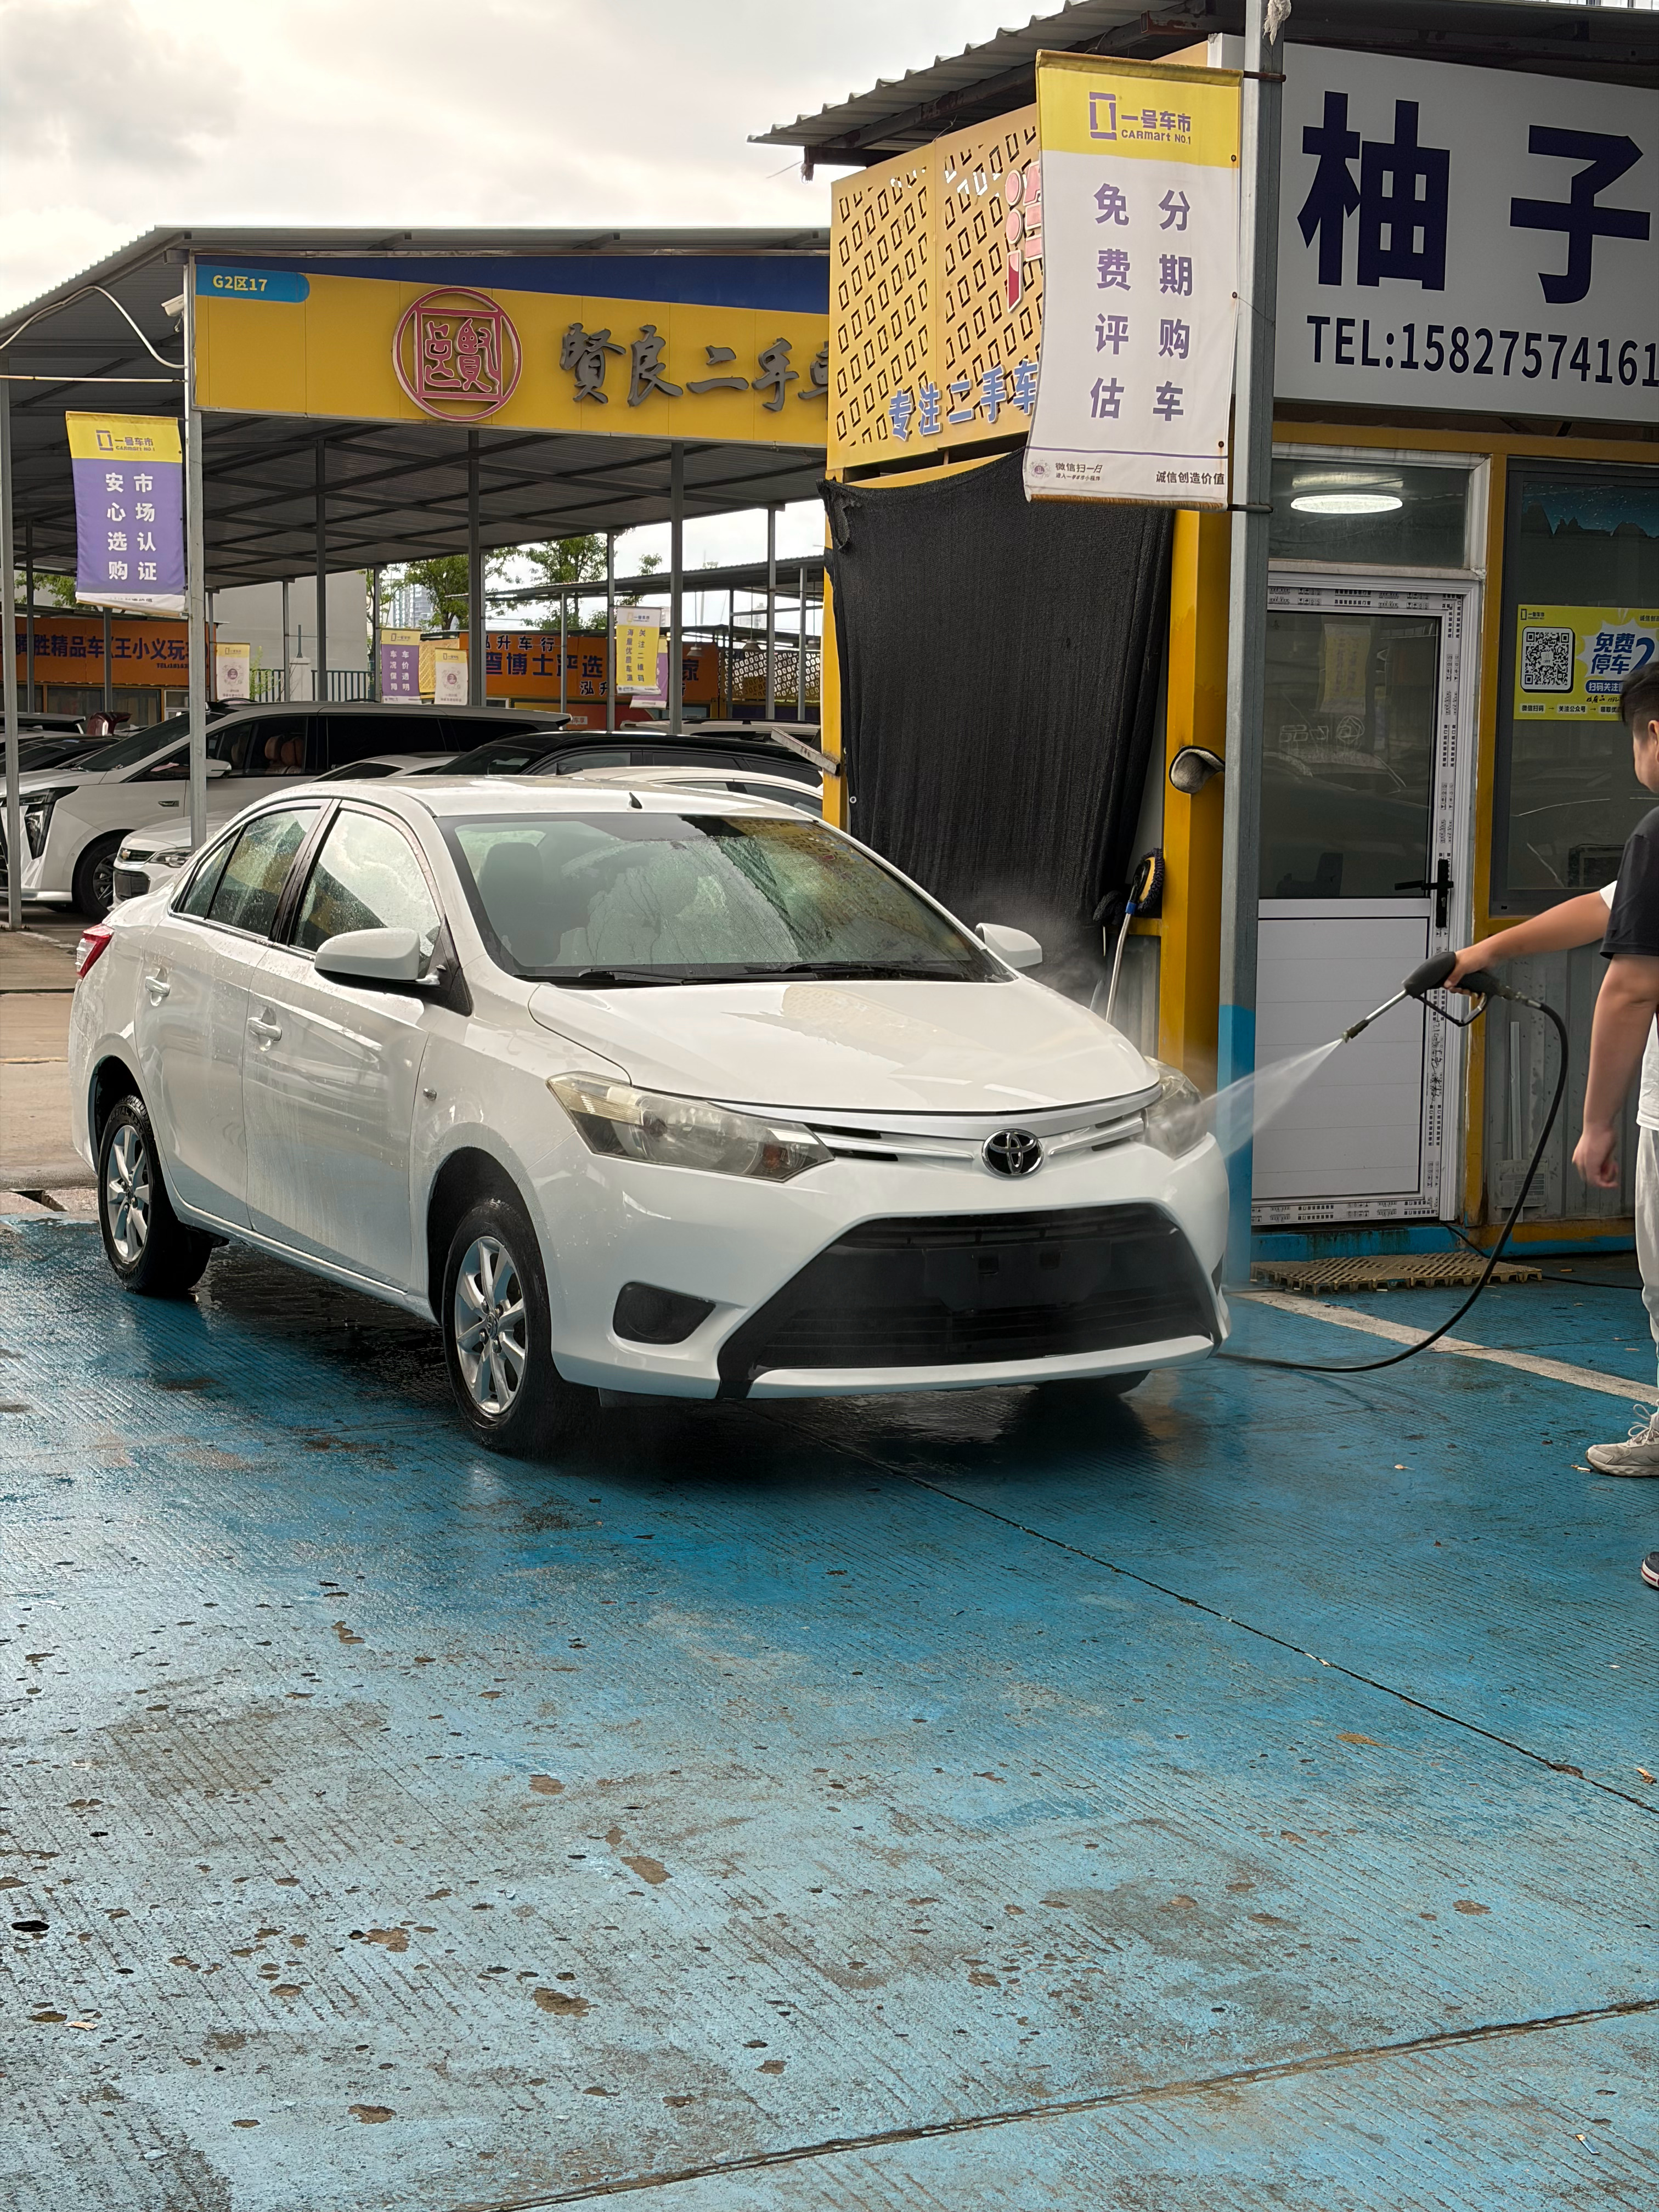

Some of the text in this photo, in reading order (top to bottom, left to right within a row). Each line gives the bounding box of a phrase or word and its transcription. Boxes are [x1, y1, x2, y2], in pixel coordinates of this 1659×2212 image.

[1121, 109, 1191, 133] 一号车市
[1121, 129, 1171, 142] CARmart
[1297, 91, 1651, 303] 柚子
[213, 275, 268, 291] G2区17
[1090, 183, 1131, 419] 免费评估
[1153, 189, 1193, 421] 分期购车
[888, 358, 1039, 442] 专注二手车
[1055, 462, 1103, 473] 微信扫一扫
[1156, 470, 1225, 485] 诚信创造价值
[105, 472, 128, 580] 安心选购
[133, 473, 157, 581] 市场认证
[1594, 632, 1635, 653] 免费
[1590, 653, 1632, 675] 停车
[1589, 682, 1623, 692] 扫码关注
